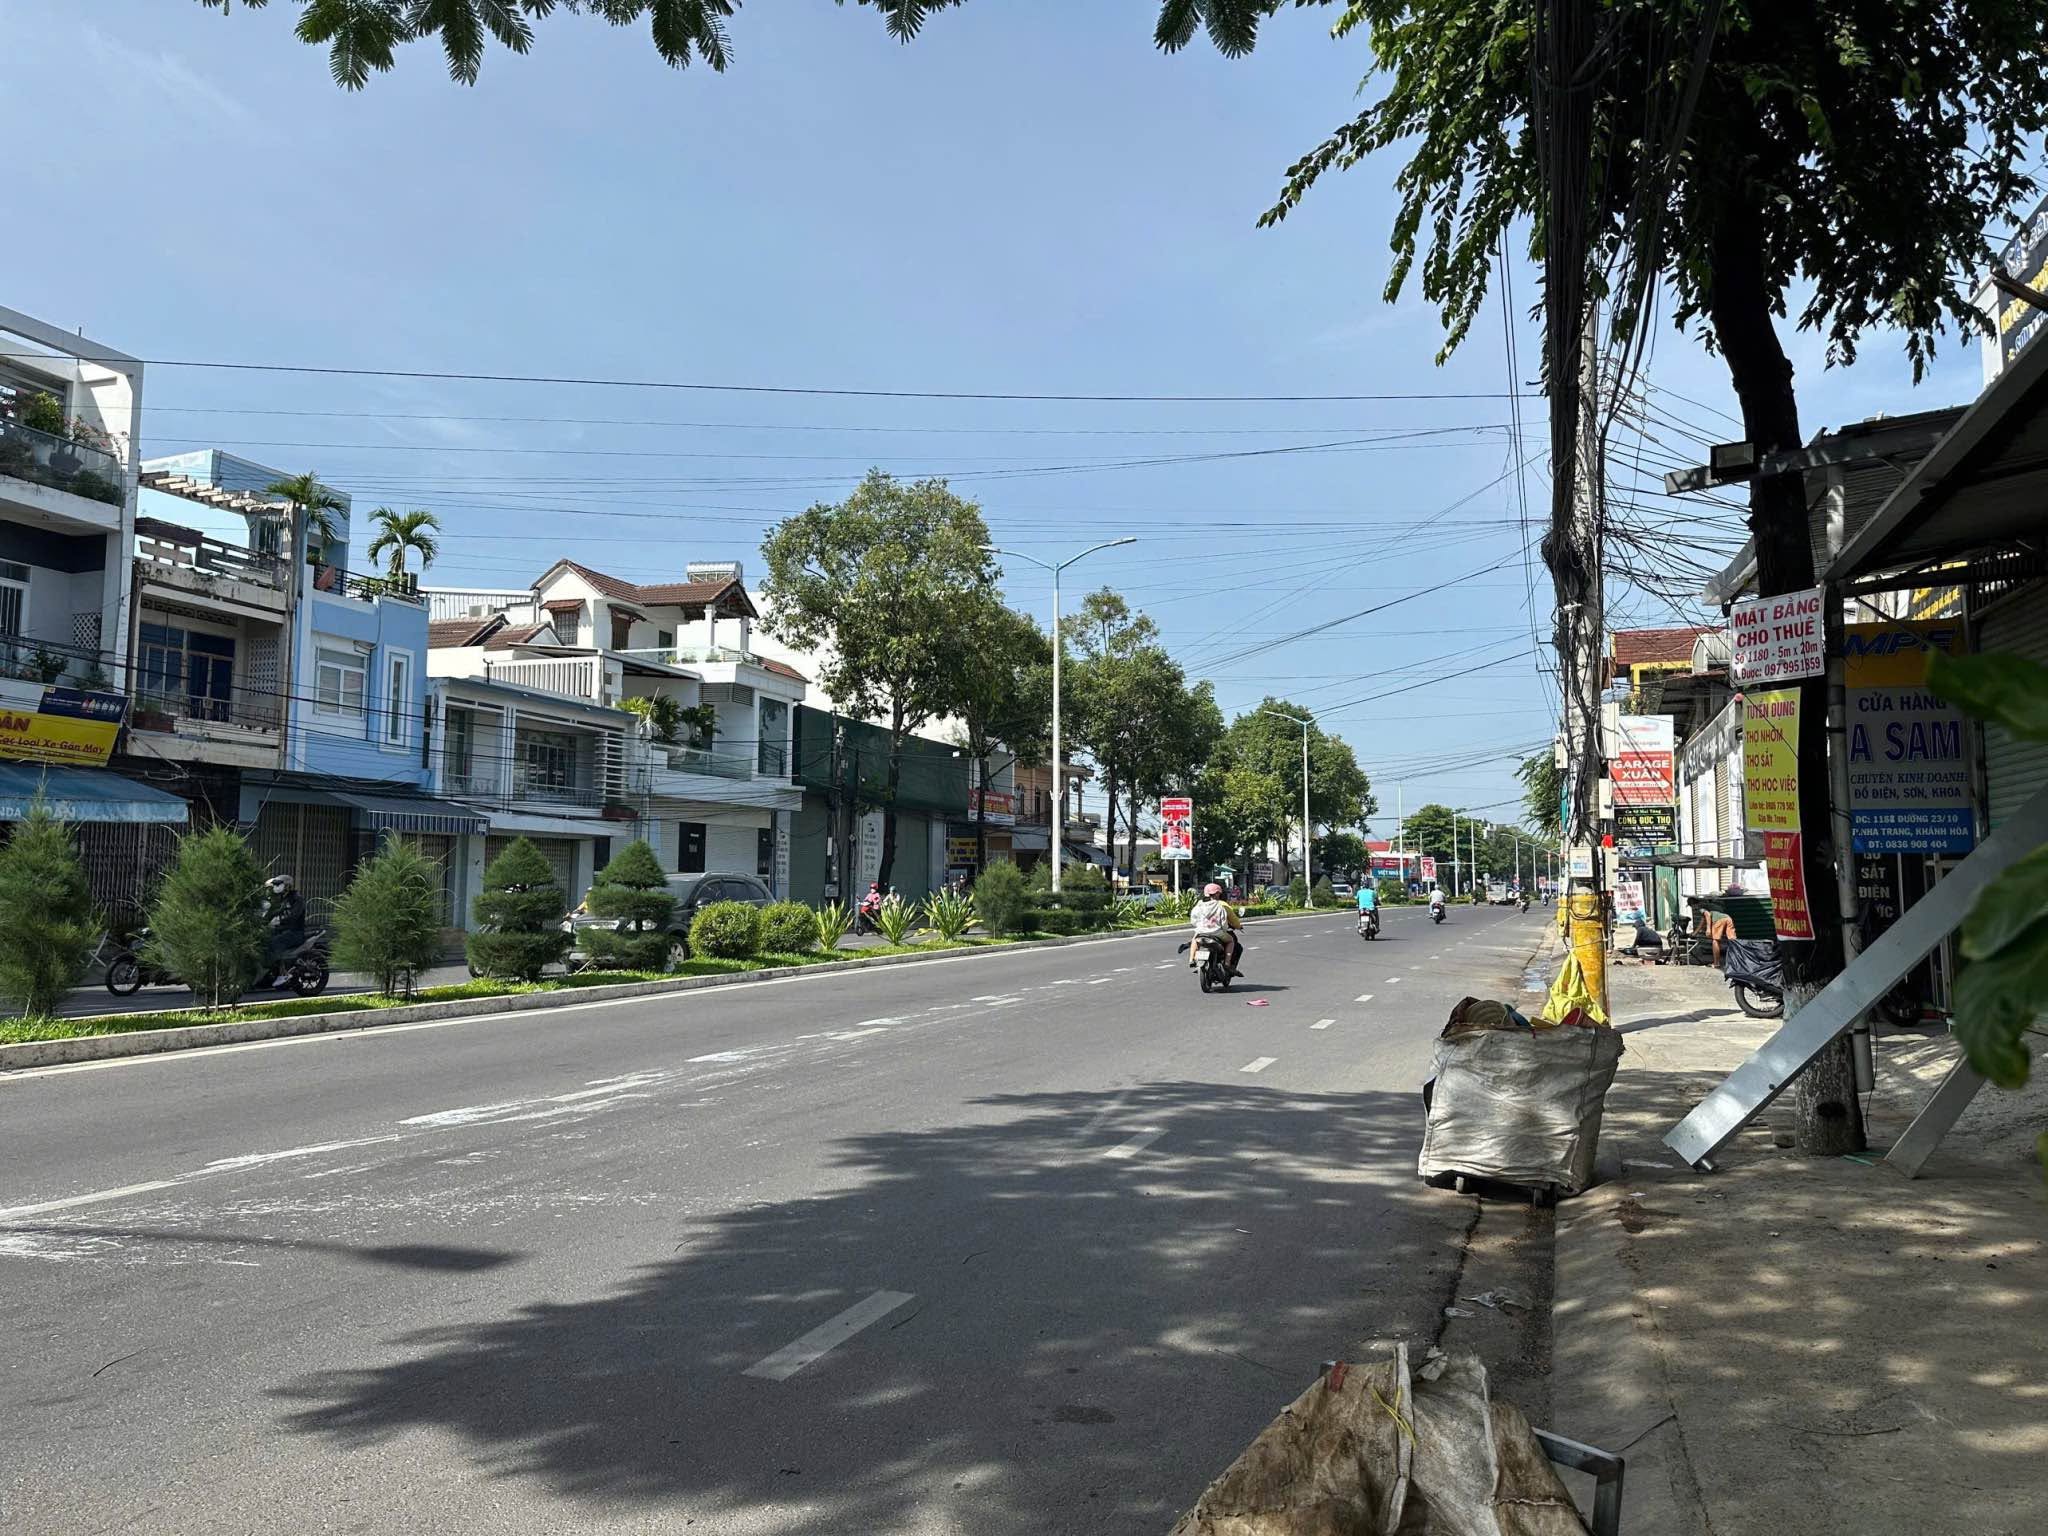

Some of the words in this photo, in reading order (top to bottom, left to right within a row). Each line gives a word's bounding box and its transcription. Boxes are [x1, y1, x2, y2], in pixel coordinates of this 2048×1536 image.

[1735, 605, 1768, 629] MẶT
[1773, 597, 1820, 620] BẰNG
[1736, 629, 1769, 648] CHO
[1772, 616, 1815, 642] THUÊ
[1747, 648, 1769, 662] 1180
[1778, 645, 1791, 658] 5m
[1800, 640, 1818, 655] 20m
[1858, 691, 1893, 712] CỬA
[1850, 723, 1873, 762] A
[1885, 720, 1961, 762] SAM
[1613, 760, 1670, 769] GARAGE
[1622, 768, 1660, 779] XUÂN
[1897, 772, 1924, 784] KINH
[1931, 814, 1959, 823] 23/10
[1930, 840, 1948, 848] 404
[1858, 884, 1891, 901] ĐIỆN
